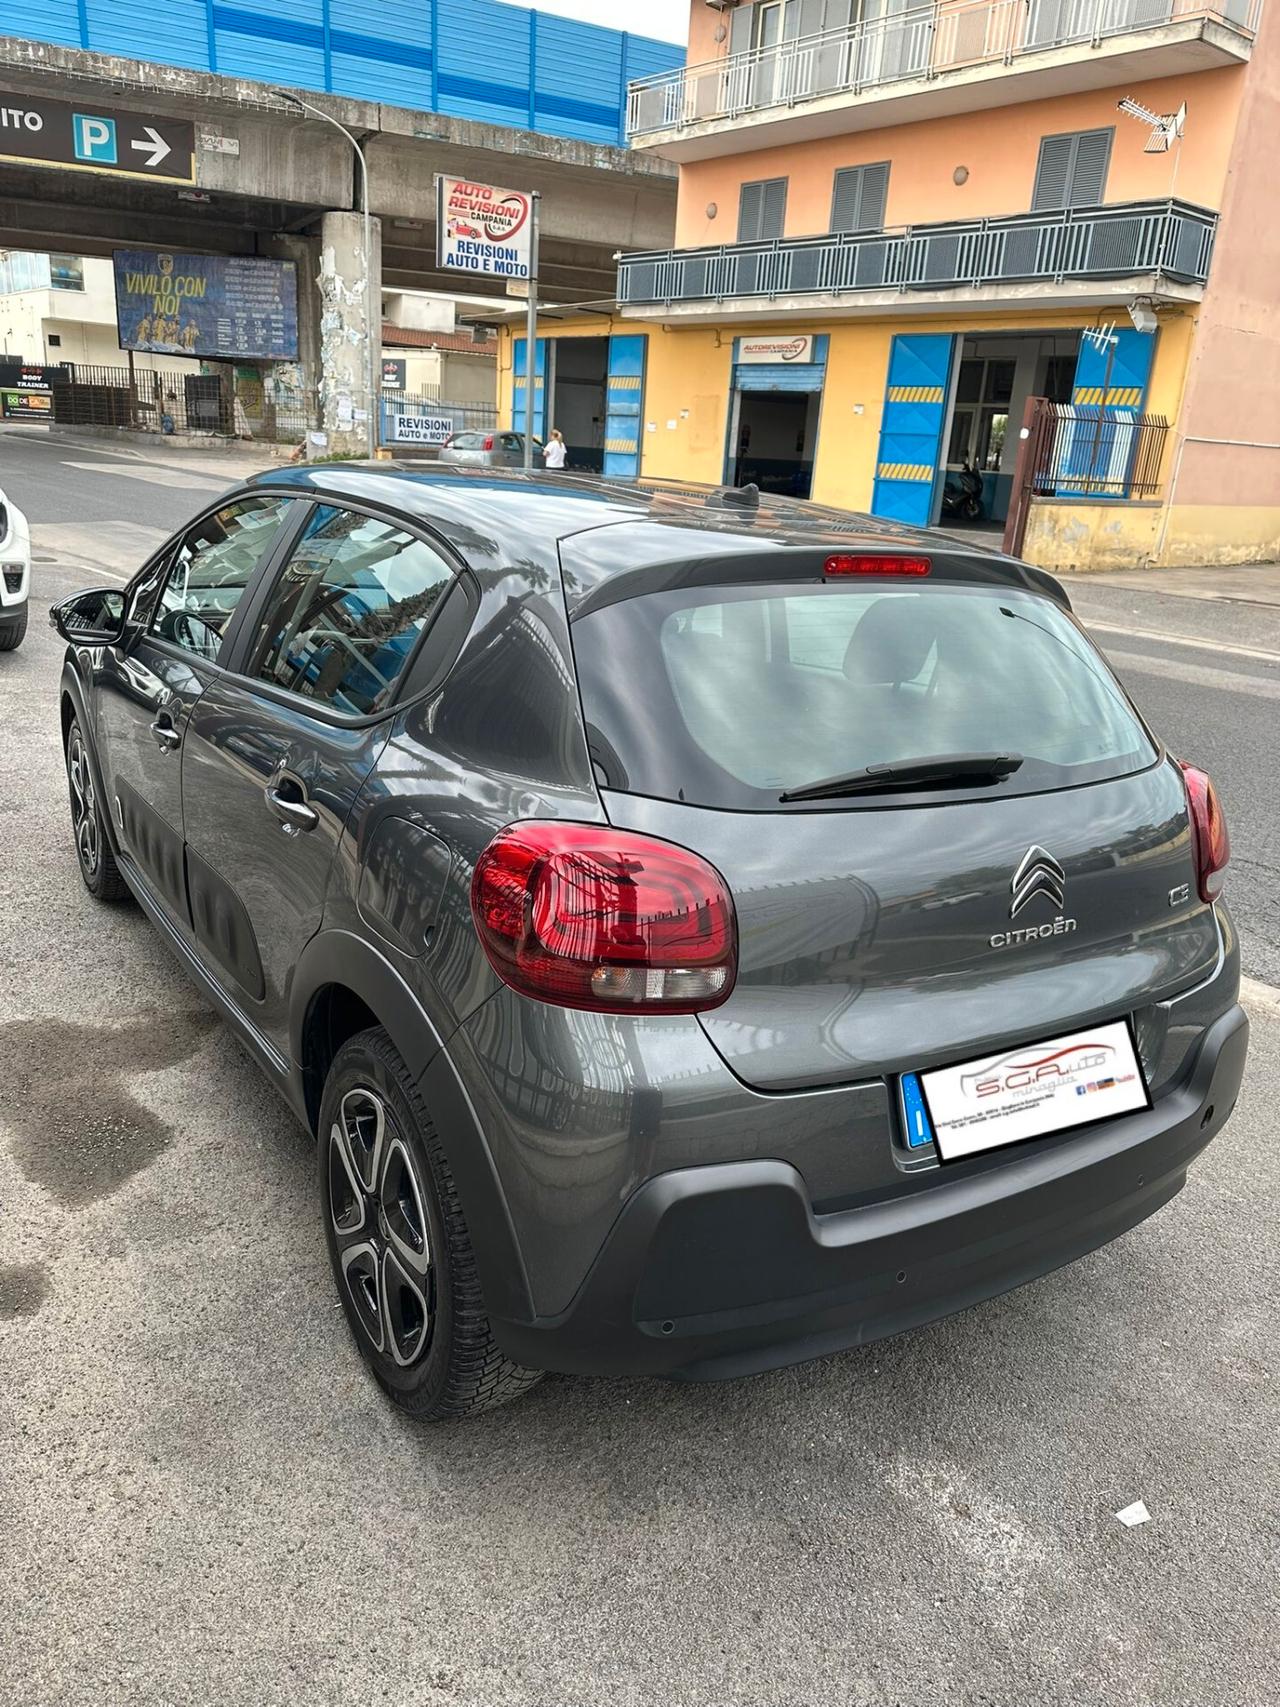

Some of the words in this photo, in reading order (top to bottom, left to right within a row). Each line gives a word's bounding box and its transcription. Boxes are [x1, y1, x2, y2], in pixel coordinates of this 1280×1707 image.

[82, 118, 110, 156] P
[452, 183, 493, 200] AUTO
[448, 196, 520, 220] REVISIONI
[470, 211, 513, 227] CAMPANIA
[457, 240, 518, 262] REVISIONI
[446, 253, 479, 270] AUTO
[483, 258, 490, 271] E
[494, 260, 528, 277] MOTO
[126, 272, 173, 296] VIVILO
[174, 275, 207, 298] CON
[153, 295, 181, 315] NOI
[398, 418, 451, 431] REVISIONI
[398, 430, 421, 438] AUTO
